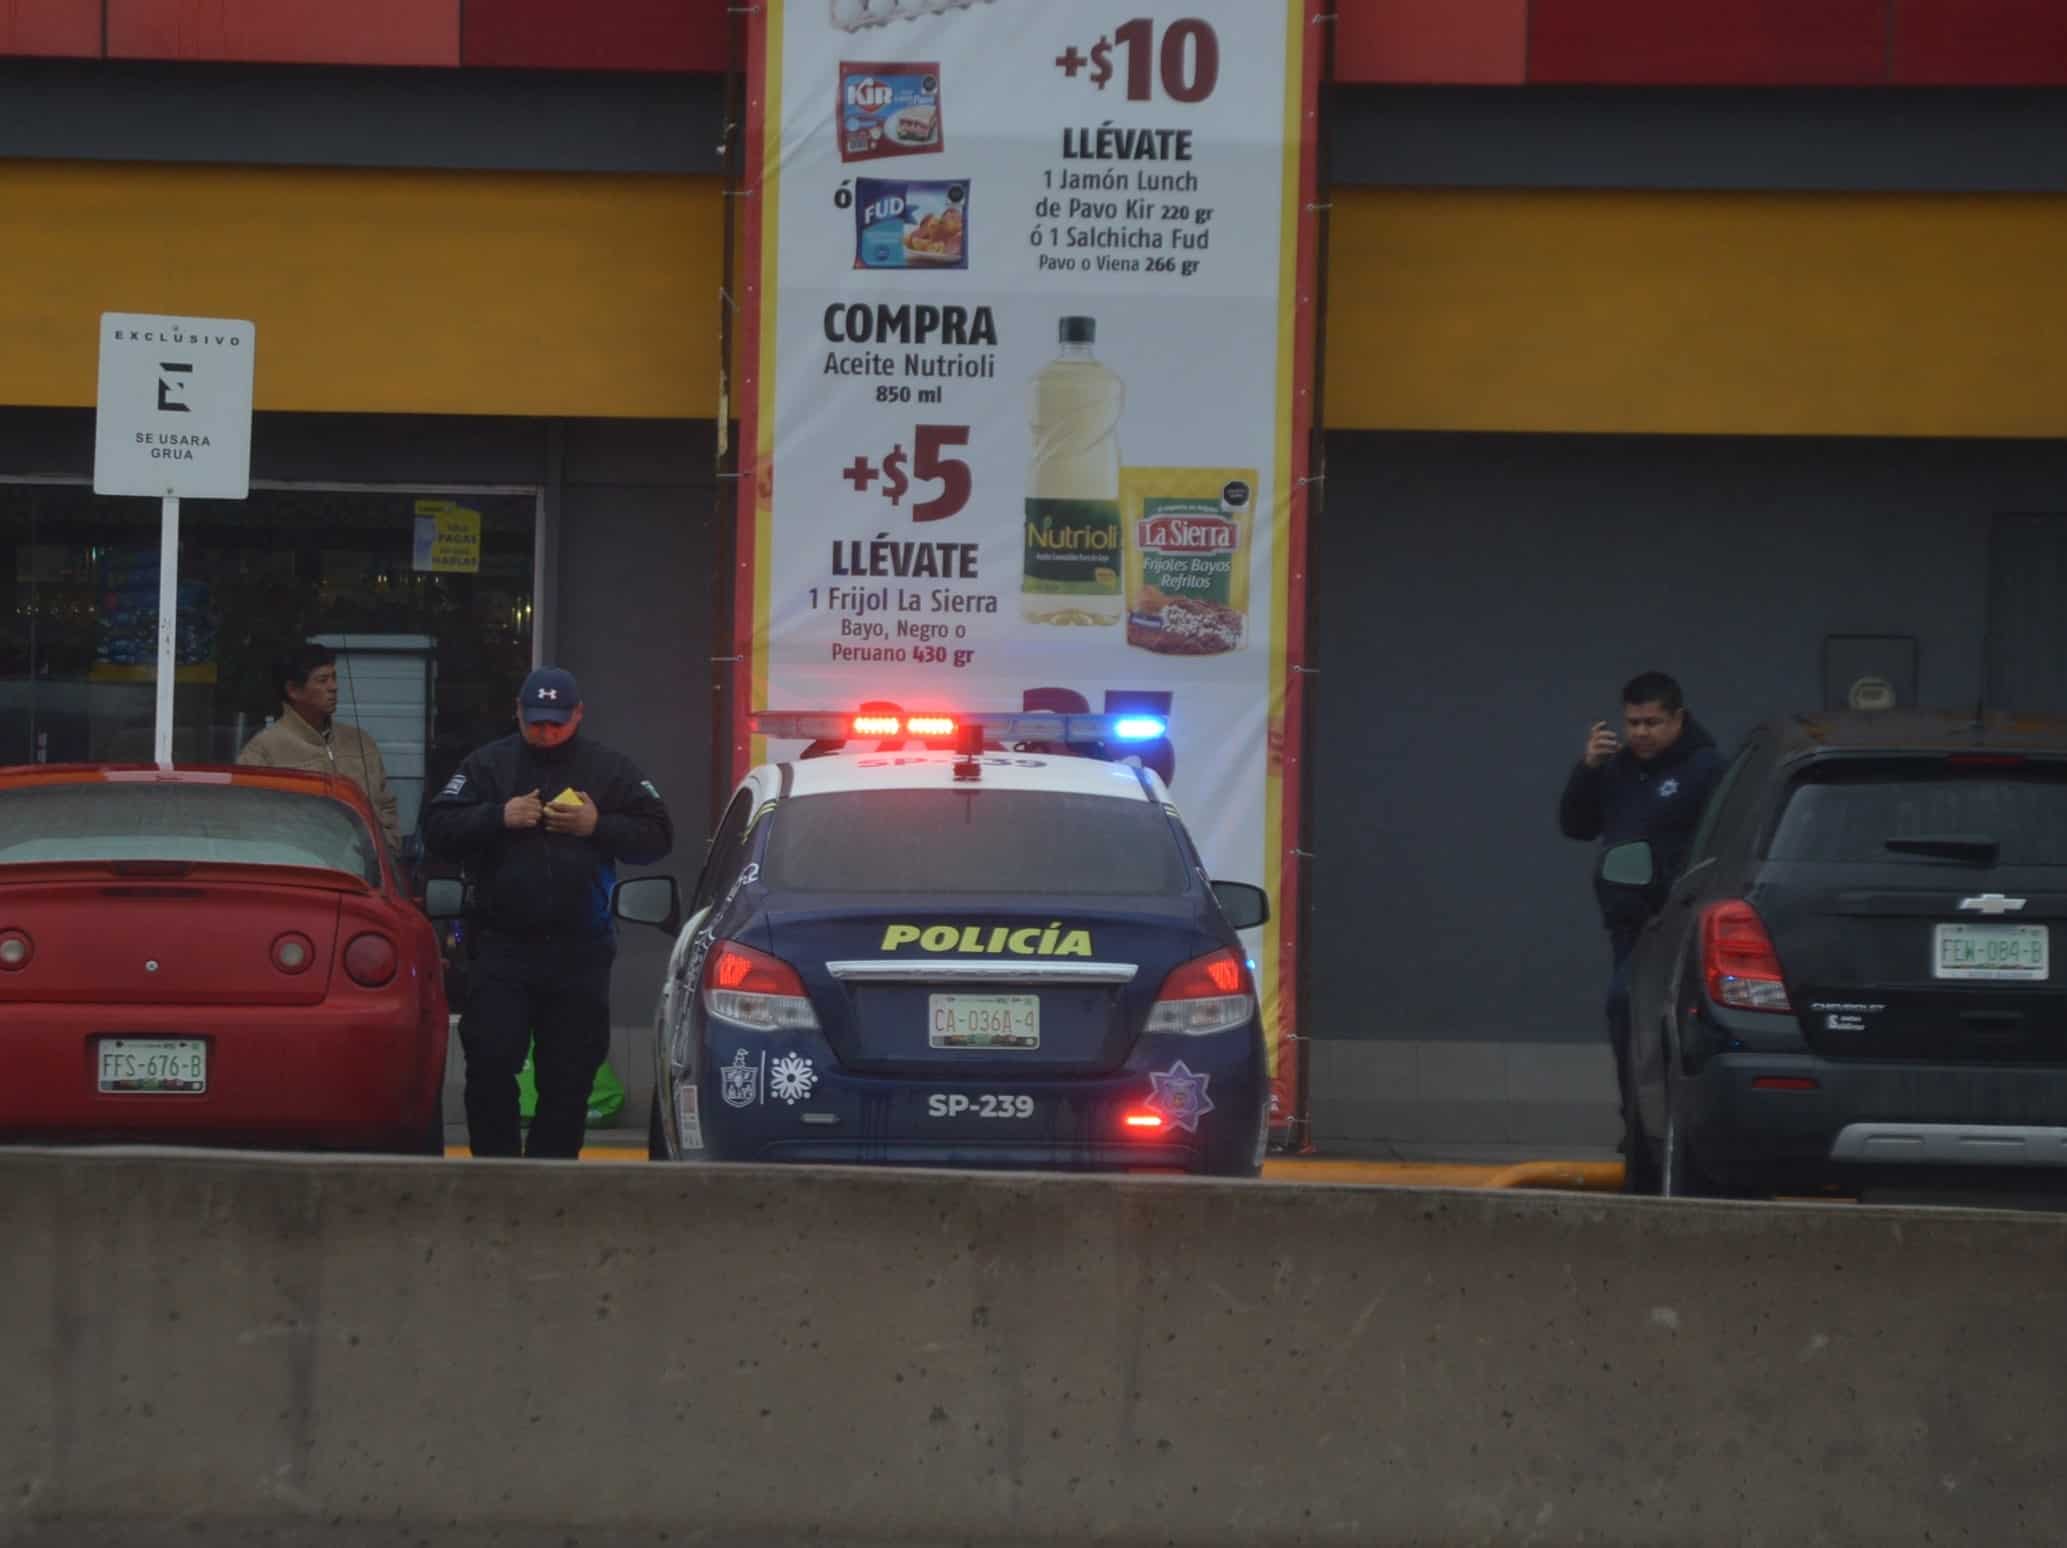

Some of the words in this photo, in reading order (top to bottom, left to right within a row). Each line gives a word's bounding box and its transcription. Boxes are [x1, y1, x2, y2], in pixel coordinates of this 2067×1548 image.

[1055, 17, 1220, 104] +$10
[1062, 120, 1193, 162] LLÉVATE
[833, 179, 853, 209] ó
[1044, 169, 1052, 189] 1
[1059, 167, 1129, 191] Jamón
[1137, 170, 1198, 193] Lunch
[864, 197, 905, 225] FUD
[1035, 196, 1061, 219] de
[1068, 197, 1118, 219] Pavo
[1125, 198, 1155, 220] Kir
[1160, 205, 1190, 221] 220
[1194, 207, 1214, 225] gr
[1029, 224, 1043, 247] ó
[1049, 227, 1059, 247] 1
[1066, 226, 1163, 249] Salchicha
[1171, 228, 1209, 250] Fud
[1039, 253, 1076, 271] Pavo
[1080, 257, 1091, 271] o
[1096, 254, 1140, 272] Viena
[1144, 256, 1175, 273] 266
[1180, 260, 1201, 277] gr
[114, 327, 240, 347] EXCLUSIVO
[823, 302, 998, 346] COMPRA
[823, 351, 895, 377] Aceite
[904, 352, 995, 379] Nutrioli
[875, 385, 912, 403] 850
[917, 385, 942, 404] ml
[135, 431, 153, 444] SE
[158, 433, 211, 447] USARA
[150, 447, 193, 461] GRUA
[842, 423, 972, 523] +$5
[1026, 520, 1118, 550] Nutrioli
[1144, 523, 1167, 545] La
[1169, 519, 1231, 546] Sierra
[831, 531, 979, 579] LLÉVATE
[808, 587, 819, 609] 1
[828, 585, 889, 617] Frijol
[898, 588, 921, 612] La
[930, 587, 998, 614] Sierra
[840, 614, 889, 641] Bayo,
[896, 619, 949, 643] Negro
[954, 624, 967, 639] o
[831, 642, 907, 662] Peruano
[912, 645, 948, 664] 430
[953, 649, 975, 668] gr
[880, 922, 1093, 956] POLICÍA
[103, 1053, 201, 1077] FFS-676-B
[927, 1093, 1035, 1119] SP-239
